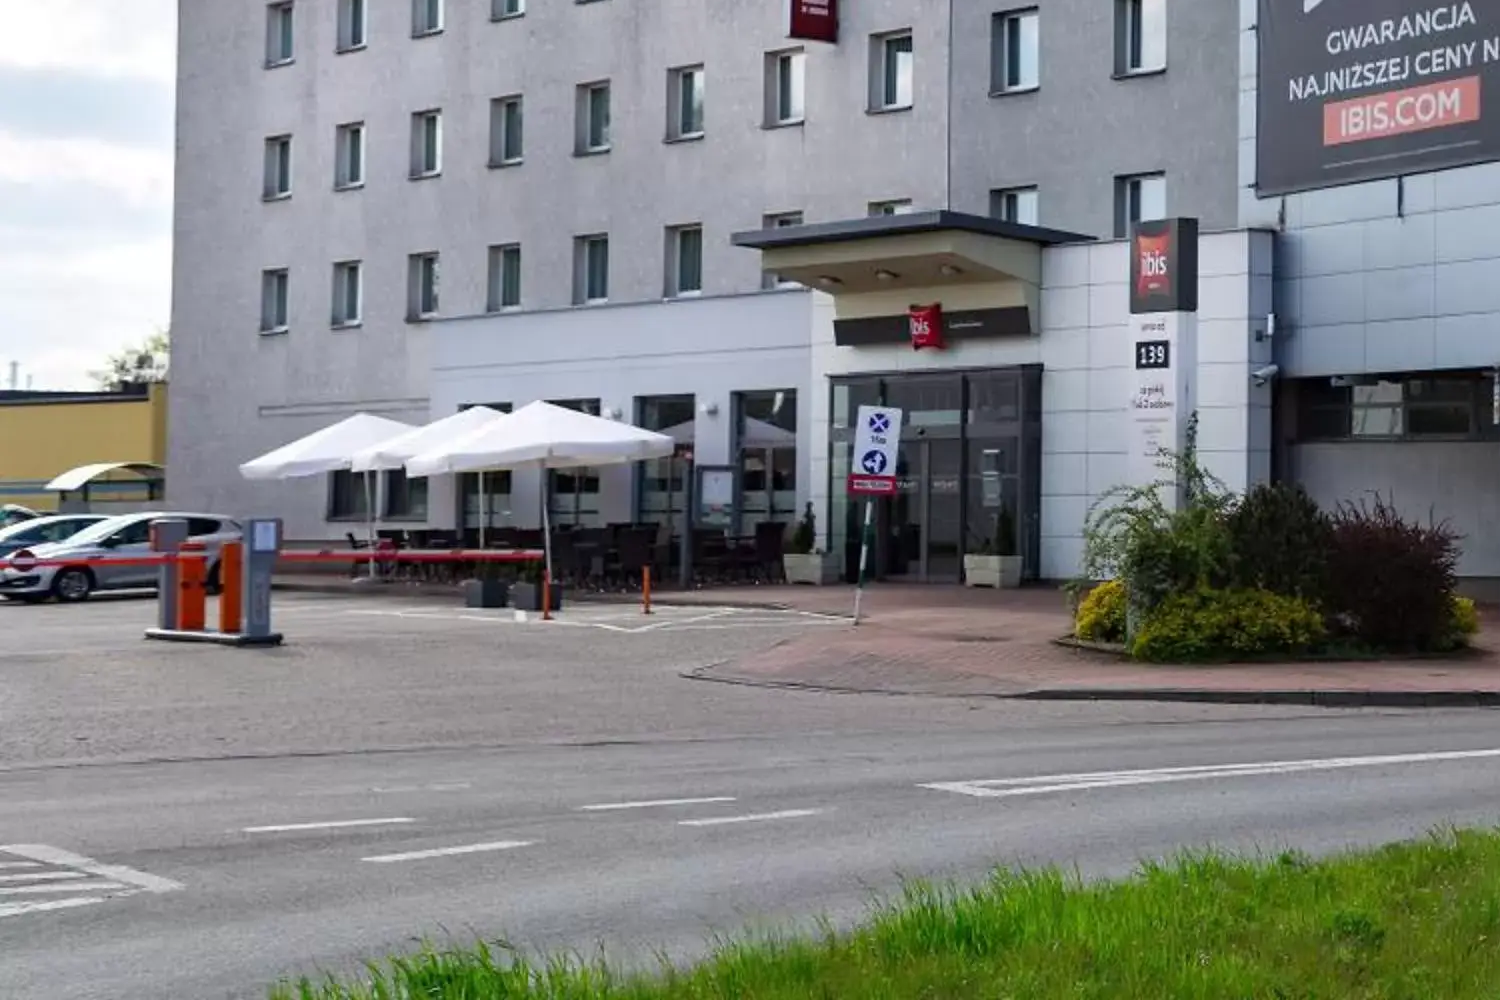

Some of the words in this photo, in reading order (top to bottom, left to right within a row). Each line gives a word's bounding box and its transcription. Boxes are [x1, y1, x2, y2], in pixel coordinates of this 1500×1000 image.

[1326, 0, 1477, 55] GWARANCJA
[1289, 54, 1411, 101] NAJNIŻSZEJ
[1415, 41, 1477, 76] CENY
[1340, 87, 1460, 137] IBIS.COM
[1141, 249, 1167, 277] ibis
[1140, 344, 1166, 365] 139
